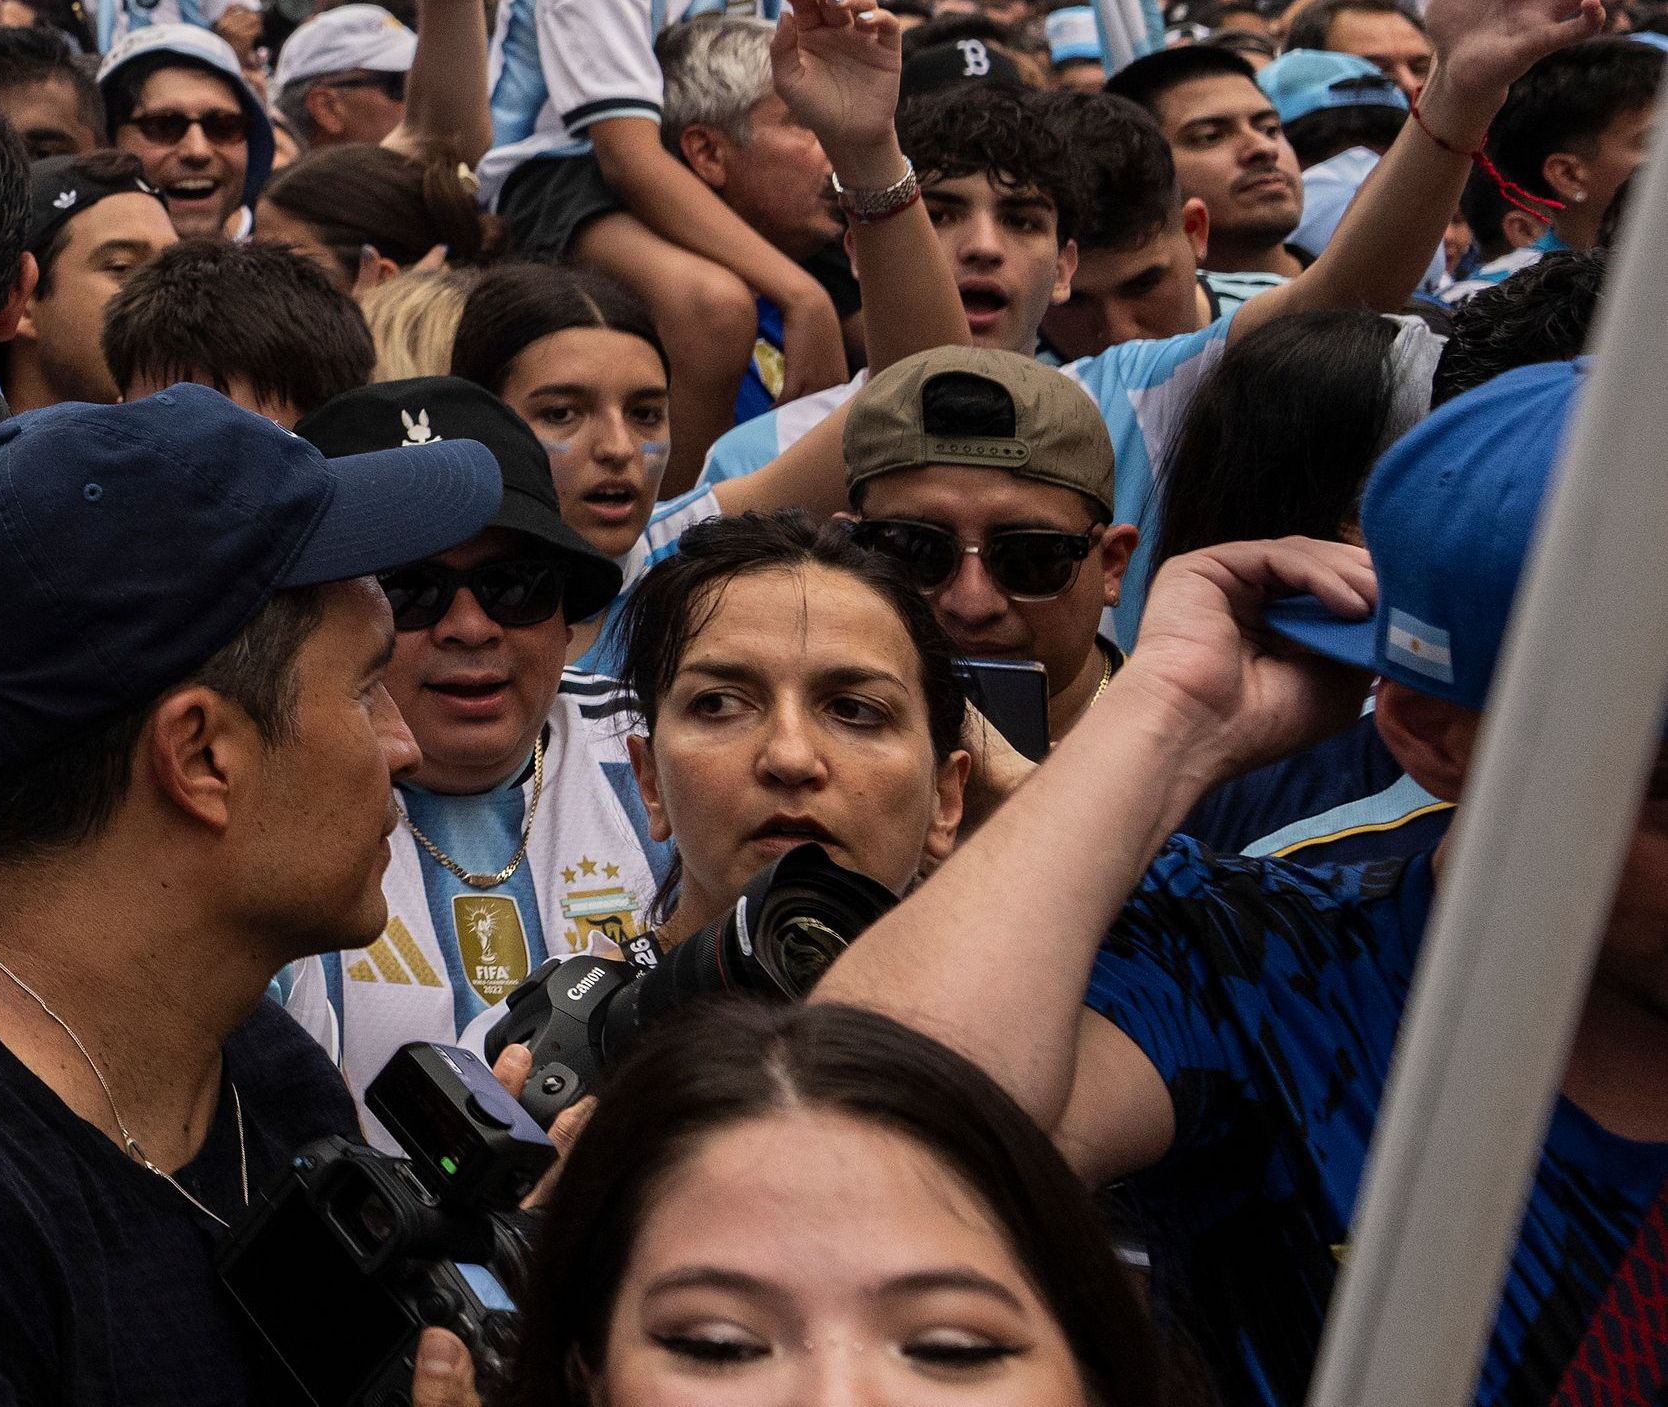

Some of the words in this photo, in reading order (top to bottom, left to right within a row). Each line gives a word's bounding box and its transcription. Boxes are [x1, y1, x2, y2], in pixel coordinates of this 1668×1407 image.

[957, 38, 990, 76] B
[475, 966, 510, 980] FIFA
[566, 966, 606, 1001] Canon
